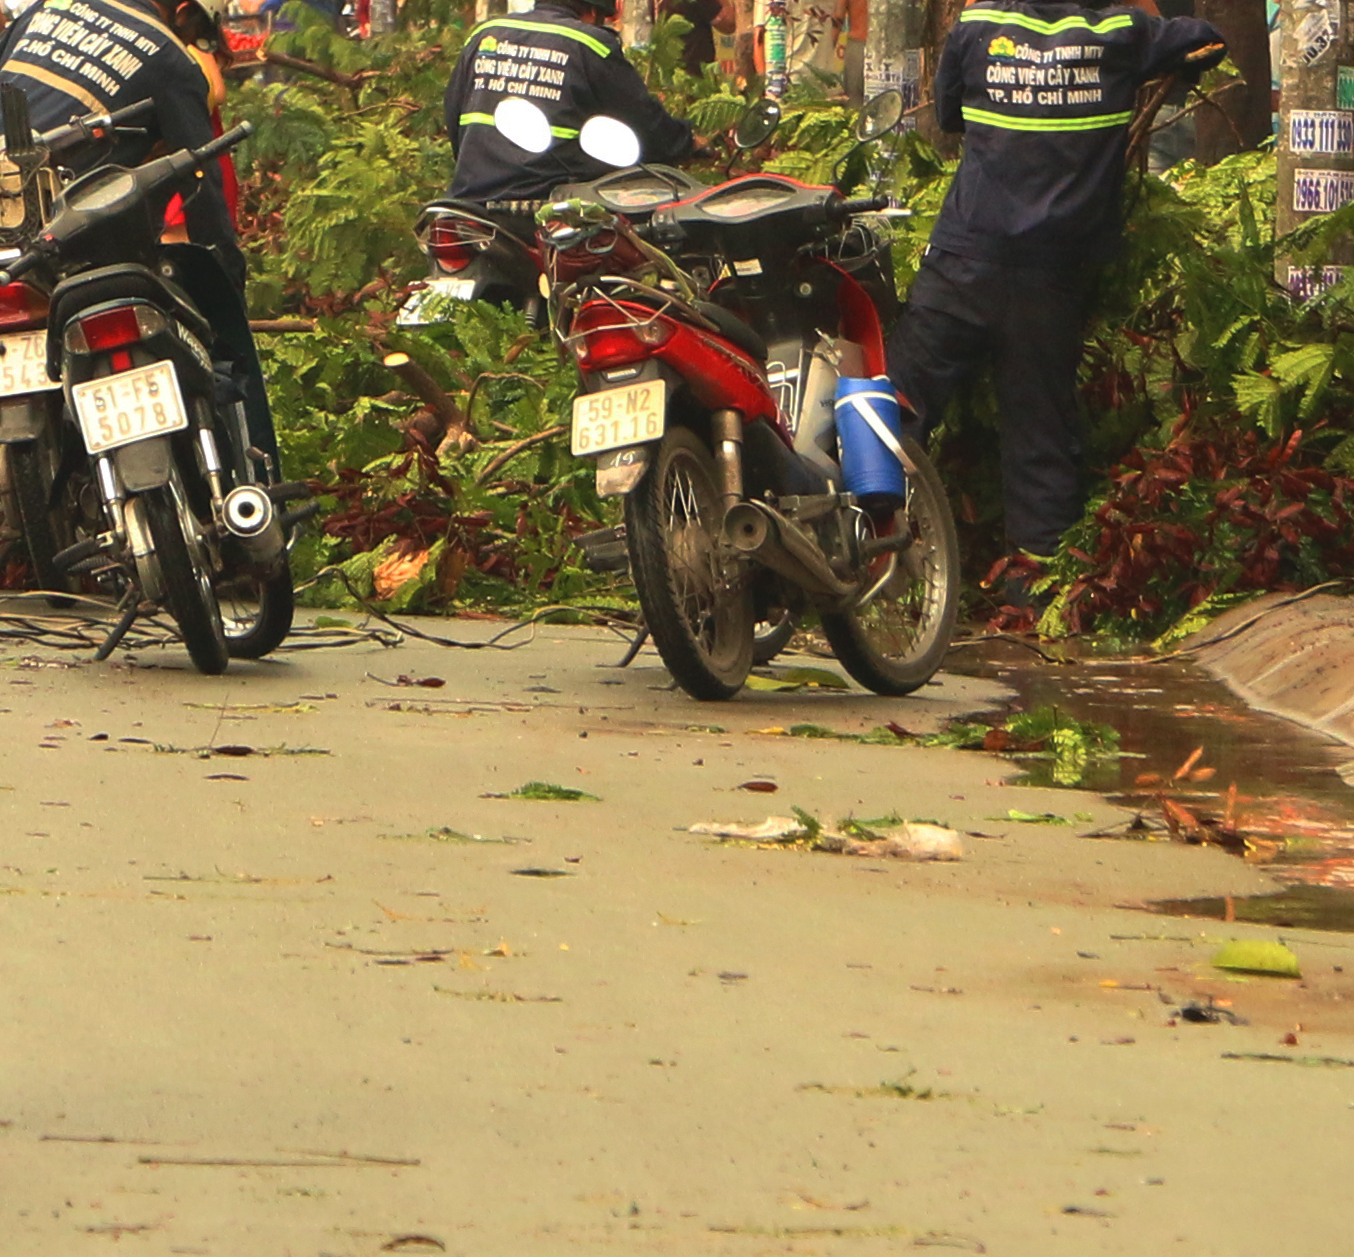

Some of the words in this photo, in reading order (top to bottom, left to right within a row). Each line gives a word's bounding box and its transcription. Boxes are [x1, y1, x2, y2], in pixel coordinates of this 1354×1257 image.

[133, 36, 160, 56] MTV
[1014, 43, 1041, 63] CÔNG
[101, 44, 143, 80] XANH
[986, 62, 1016, 84] CÔNG
[1017, 65, 1045, 85] VIÊN
[1047, 64, 1071, 85] CÂY
[1073, 66, 1100, 84] XANH
[79, 61, 120, 97] MINH
[537, 65, 565, 85] XANH
[507, 81, 529, 95] CHÍ
[528, 84, 562, 101] MINH
[987, 88, 1009, 103] TP.
[1037, 88, 1063, 105] CHÍ
[1067, 89, 1102, 104] MINH
[588, 388, 651, 423] 59-N2
[98, 402, 166, 442] 5078
[578, 411, 658, 450] 631.16
